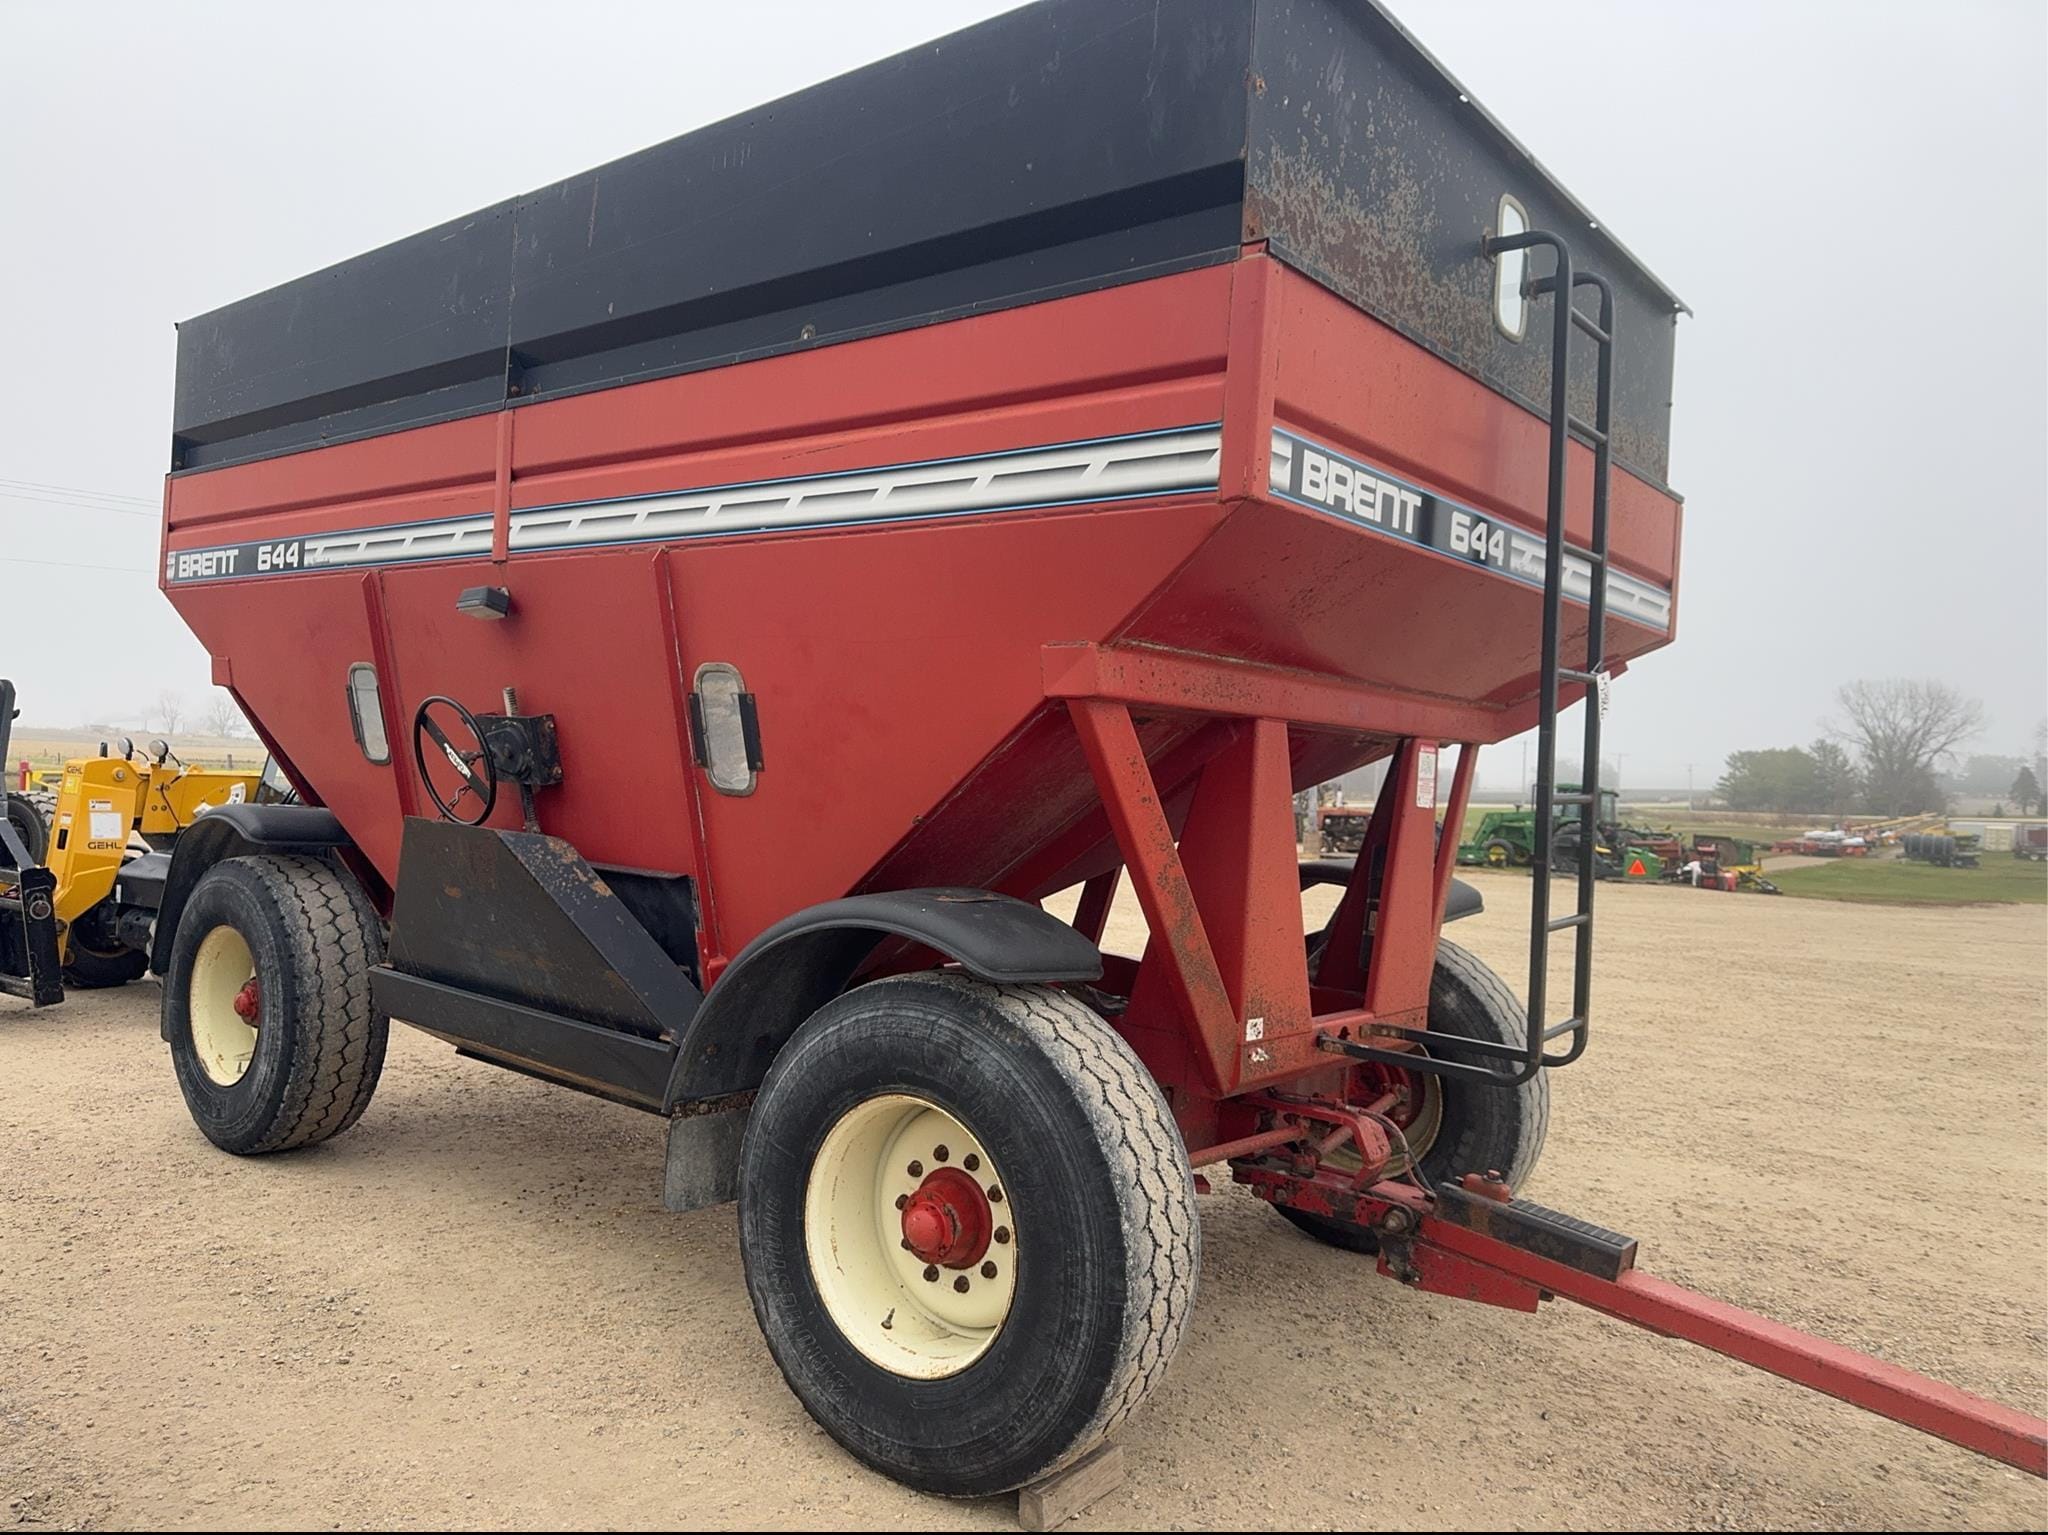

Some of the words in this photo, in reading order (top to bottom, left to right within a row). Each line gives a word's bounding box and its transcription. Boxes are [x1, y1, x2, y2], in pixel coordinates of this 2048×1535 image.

[1301, 449, 1422, 534] BRENT
[1449, 510, 1505, 566] 644
[178, 549, 239, 578] BRENT
[257, 541, 300, 571] 644
[87, 841, 122, 850] GEHL
